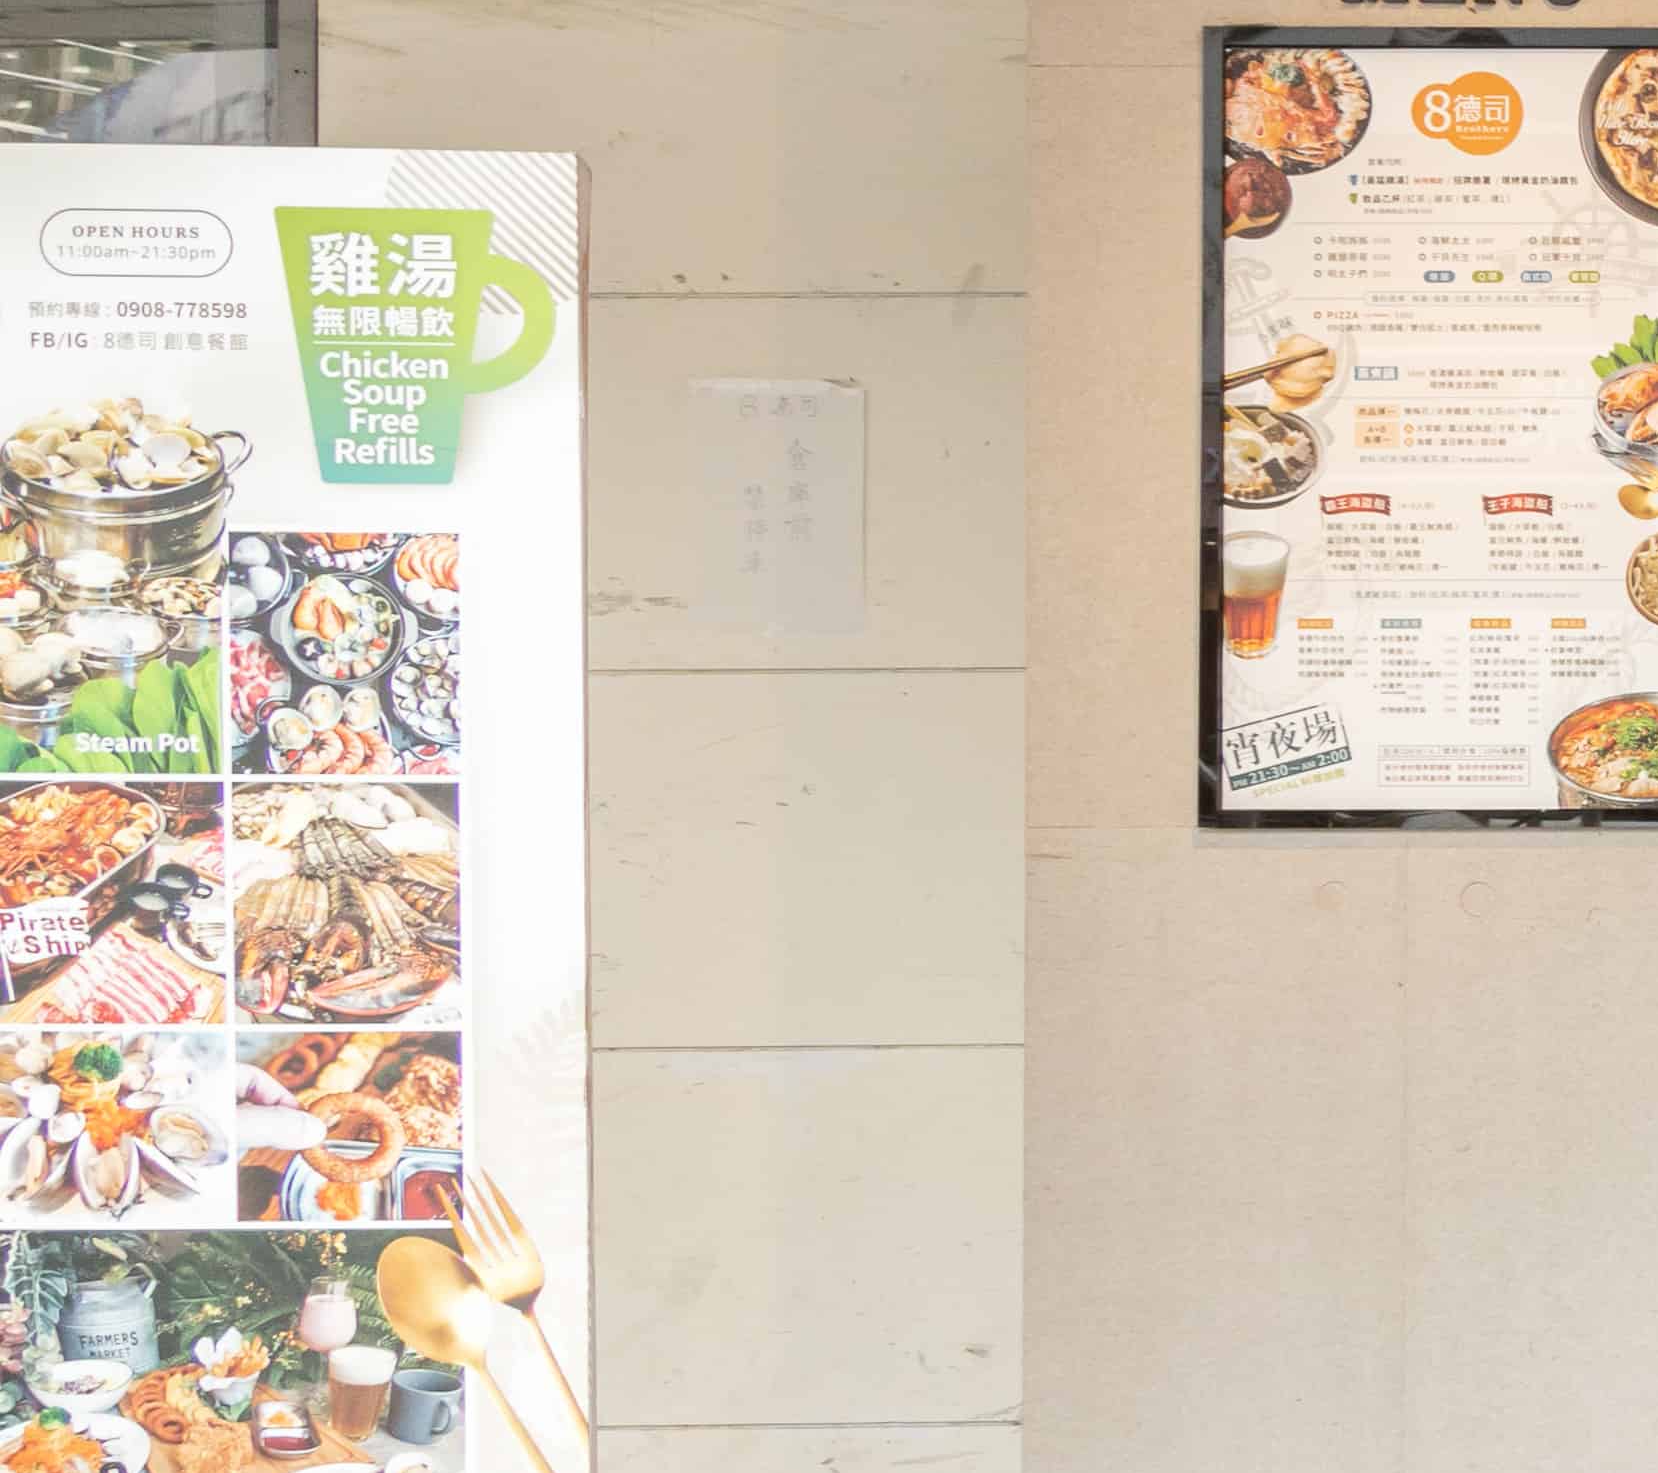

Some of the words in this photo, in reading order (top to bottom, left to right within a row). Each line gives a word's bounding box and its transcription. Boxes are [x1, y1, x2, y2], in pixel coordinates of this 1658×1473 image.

[72, 225, 124, 238] OPEN
[131, 226, 200, 239] HOURS
[310, 232, 457, 298] 雞湯
[116, 301, 248, 319] 0908-778598
[313, 305, 456, 338] 無限暢飲
[319, 351, 449, 379] Chicken
[343, 379, 427, 411] Soup
[349, 408, 420, 434] Free
[334, 437, 435, 465] Refills
[75, 732, 149, 753] Steam
[158, 732, 201, 753] Pot
[1226, 710, 1337, 770] 宵夜場
[1248, 764, 1289, 784] 21:30
[1316, 748, 1349, 767] 2:00
[0, 911, 86, 935] Pirate
[23, 934, 90, 956] Ship
[79, 1330, 139, 1350] FARMERS
